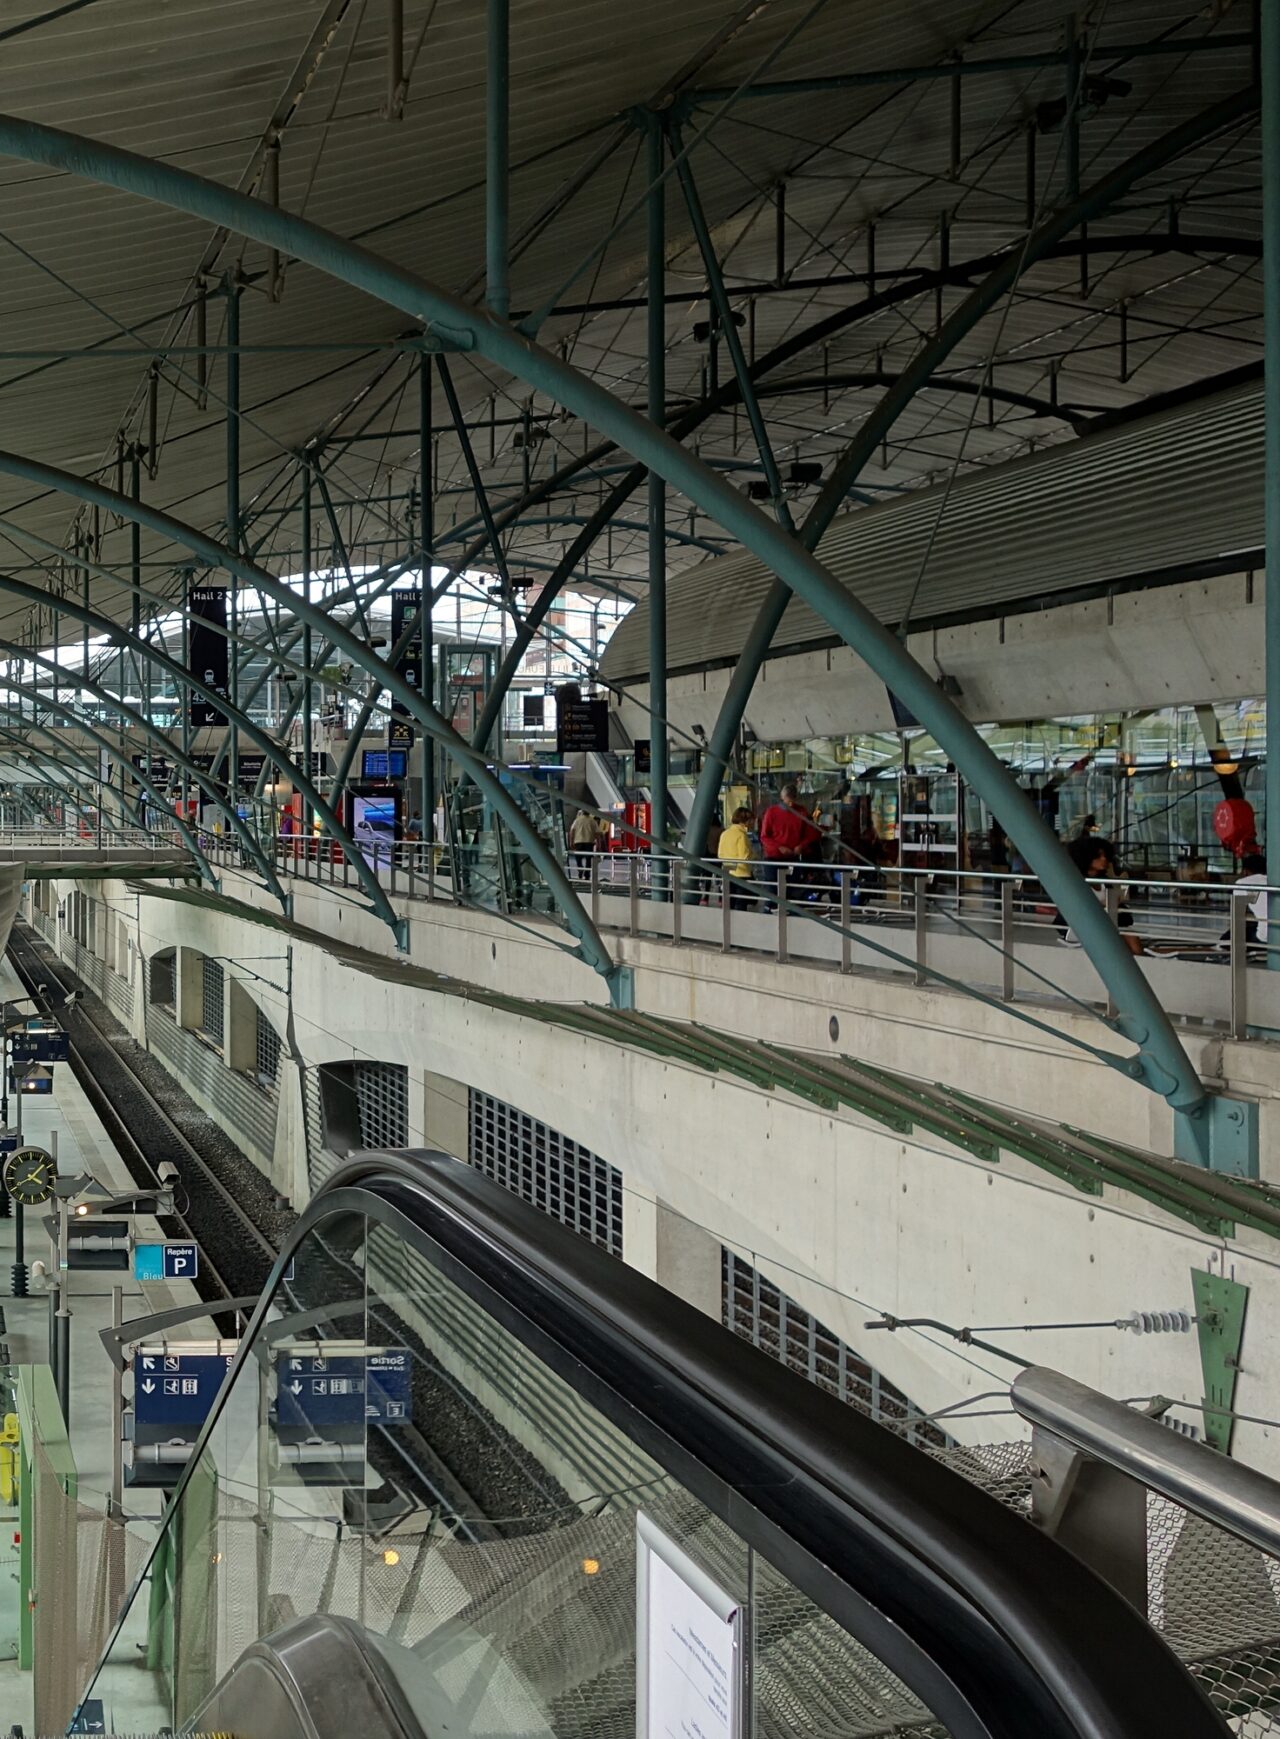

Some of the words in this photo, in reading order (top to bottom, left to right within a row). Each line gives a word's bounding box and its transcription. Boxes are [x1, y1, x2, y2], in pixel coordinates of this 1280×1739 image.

[193, 591, 214, 600] Hall
[217, 592, 223, 600] 2
[395, 592, 416, 600] Hall
[167, 1248, 193, 1256] Repère
[174, 1258, 187, 1275] P
